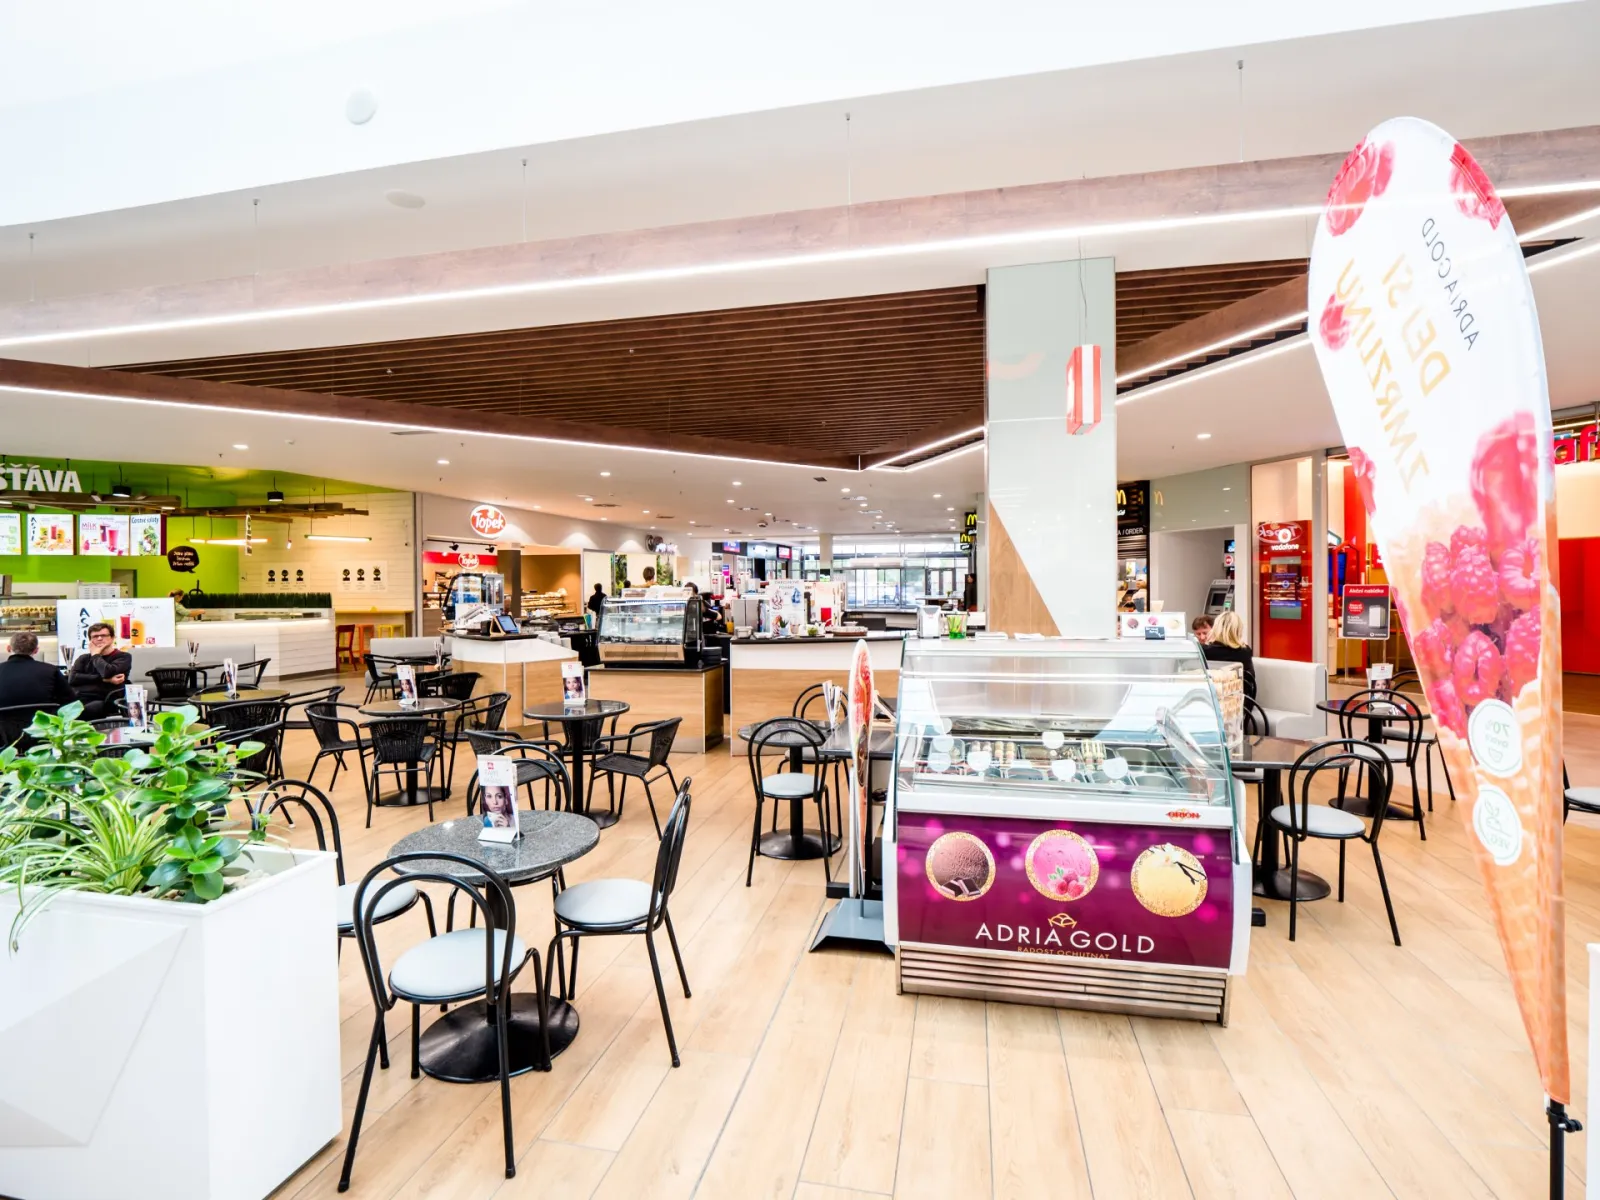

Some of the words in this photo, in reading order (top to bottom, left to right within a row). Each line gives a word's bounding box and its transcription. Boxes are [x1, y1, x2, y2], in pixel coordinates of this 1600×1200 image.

[473, 512, 504, 533] Topek
[1125, 527, 1144, 536] ORDER
[975, 922, 1062, 947] ADRIA
[1070, 930, 1155, 954] GOLD
[1017, 946, 1054, 955] RADOST
